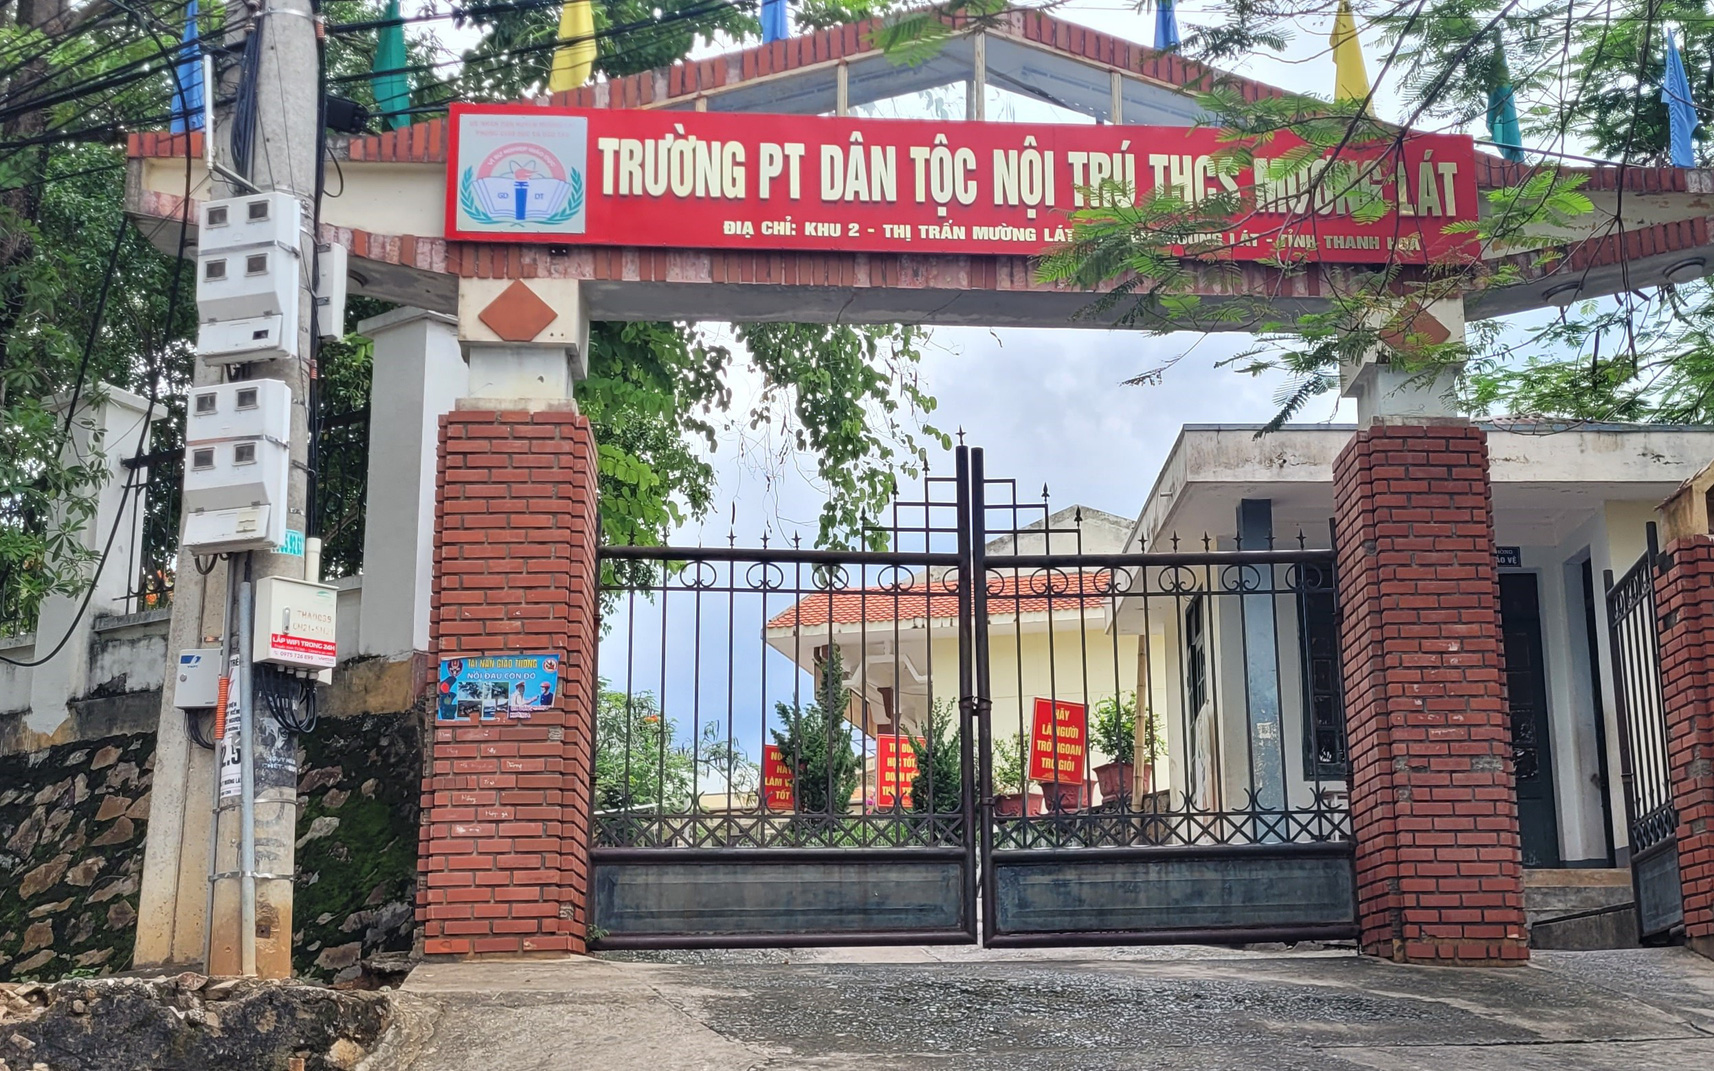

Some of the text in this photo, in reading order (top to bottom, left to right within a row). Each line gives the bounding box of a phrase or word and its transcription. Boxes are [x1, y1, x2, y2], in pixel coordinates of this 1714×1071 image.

[598, 123, 746, 199] TRƯỜNG
[759, 142, 805, 199] PT
[820, 131, 897, 202] DÂN
[910, 133, 978, 217] TỘC
[993, 135, 1055, 219] NỘI
[1068, 140, 1136, 209] TRÚ
[1149, 153, 1241, 213] THCS
[1399, 149, 1458, 217] LÁT
[761, 216, 796, 236] CHỈ:
[804, 222, 841, 237] KHU
[848, 223, 860, 237] 2
[883, 224, 911, 242] THỊ
[918, 220, 966, 240] TRẤN
[972, 222, 1036, 242] MƯỜNG
[1044, 225, 1075, 242] LÁT
[1229, 230, 1260, 247] LÁT
[1323, 235, 1380, 249] THANH
[468, 659, 478, 668] TAI
[496, 659, 513, 669] GIAO
[1058, 756, 1075, 772] GIỎI
[775, 788, 791, 800] TỐT
